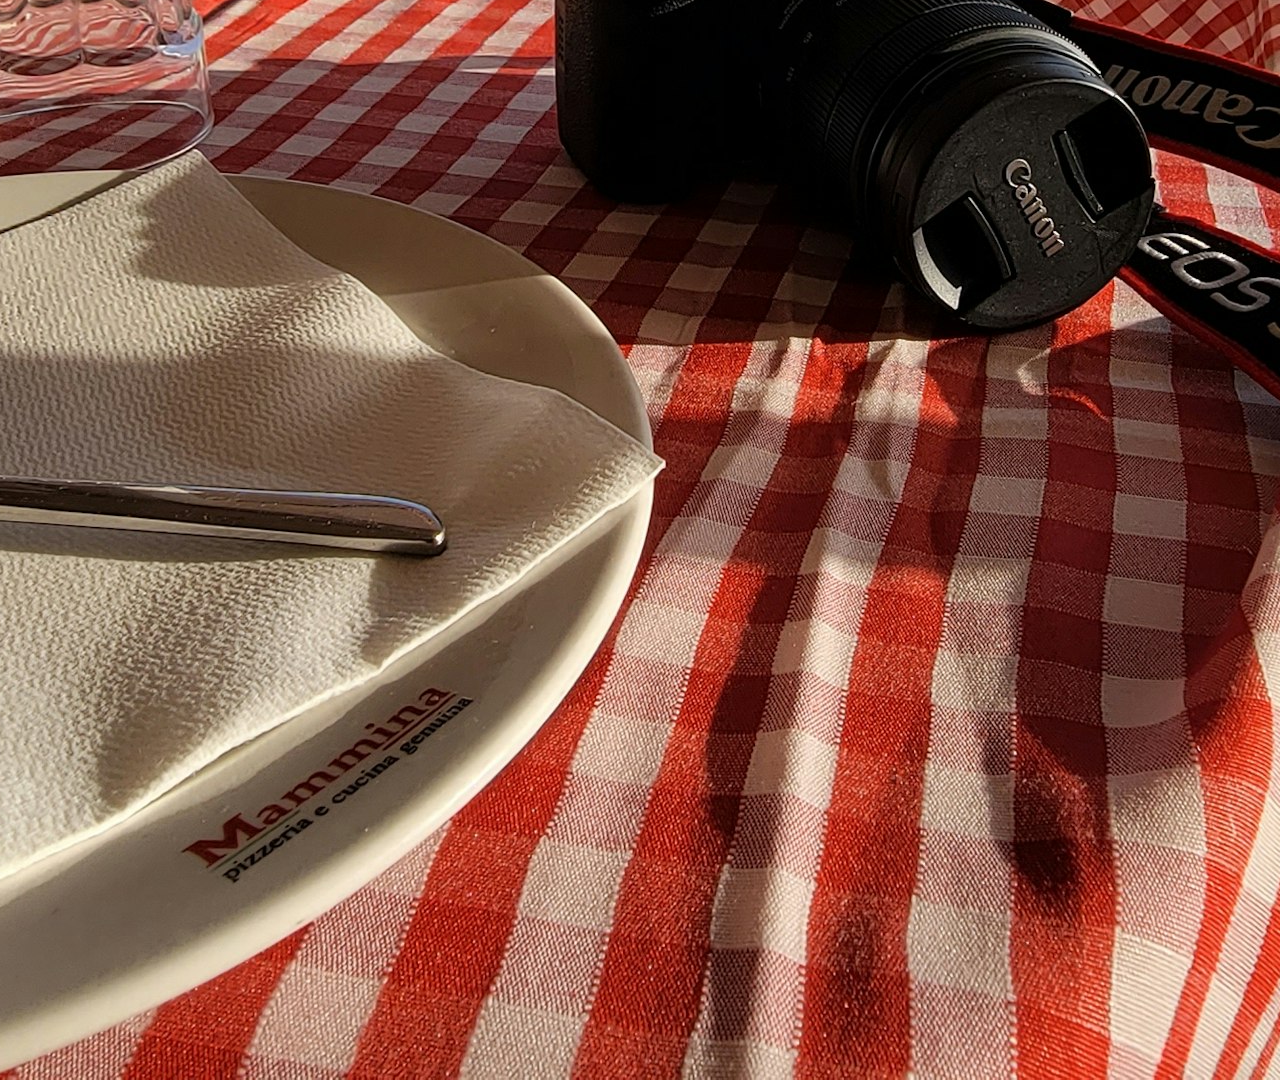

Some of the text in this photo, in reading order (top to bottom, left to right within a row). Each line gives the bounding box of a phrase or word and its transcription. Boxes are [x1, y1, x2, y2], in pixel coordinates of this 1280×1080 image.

[1005, 158, 1065, 258] Canon
[181, 687, 451, 869] Mammina
[222, 697, 474, 884] pizzeria e cucina genuina
